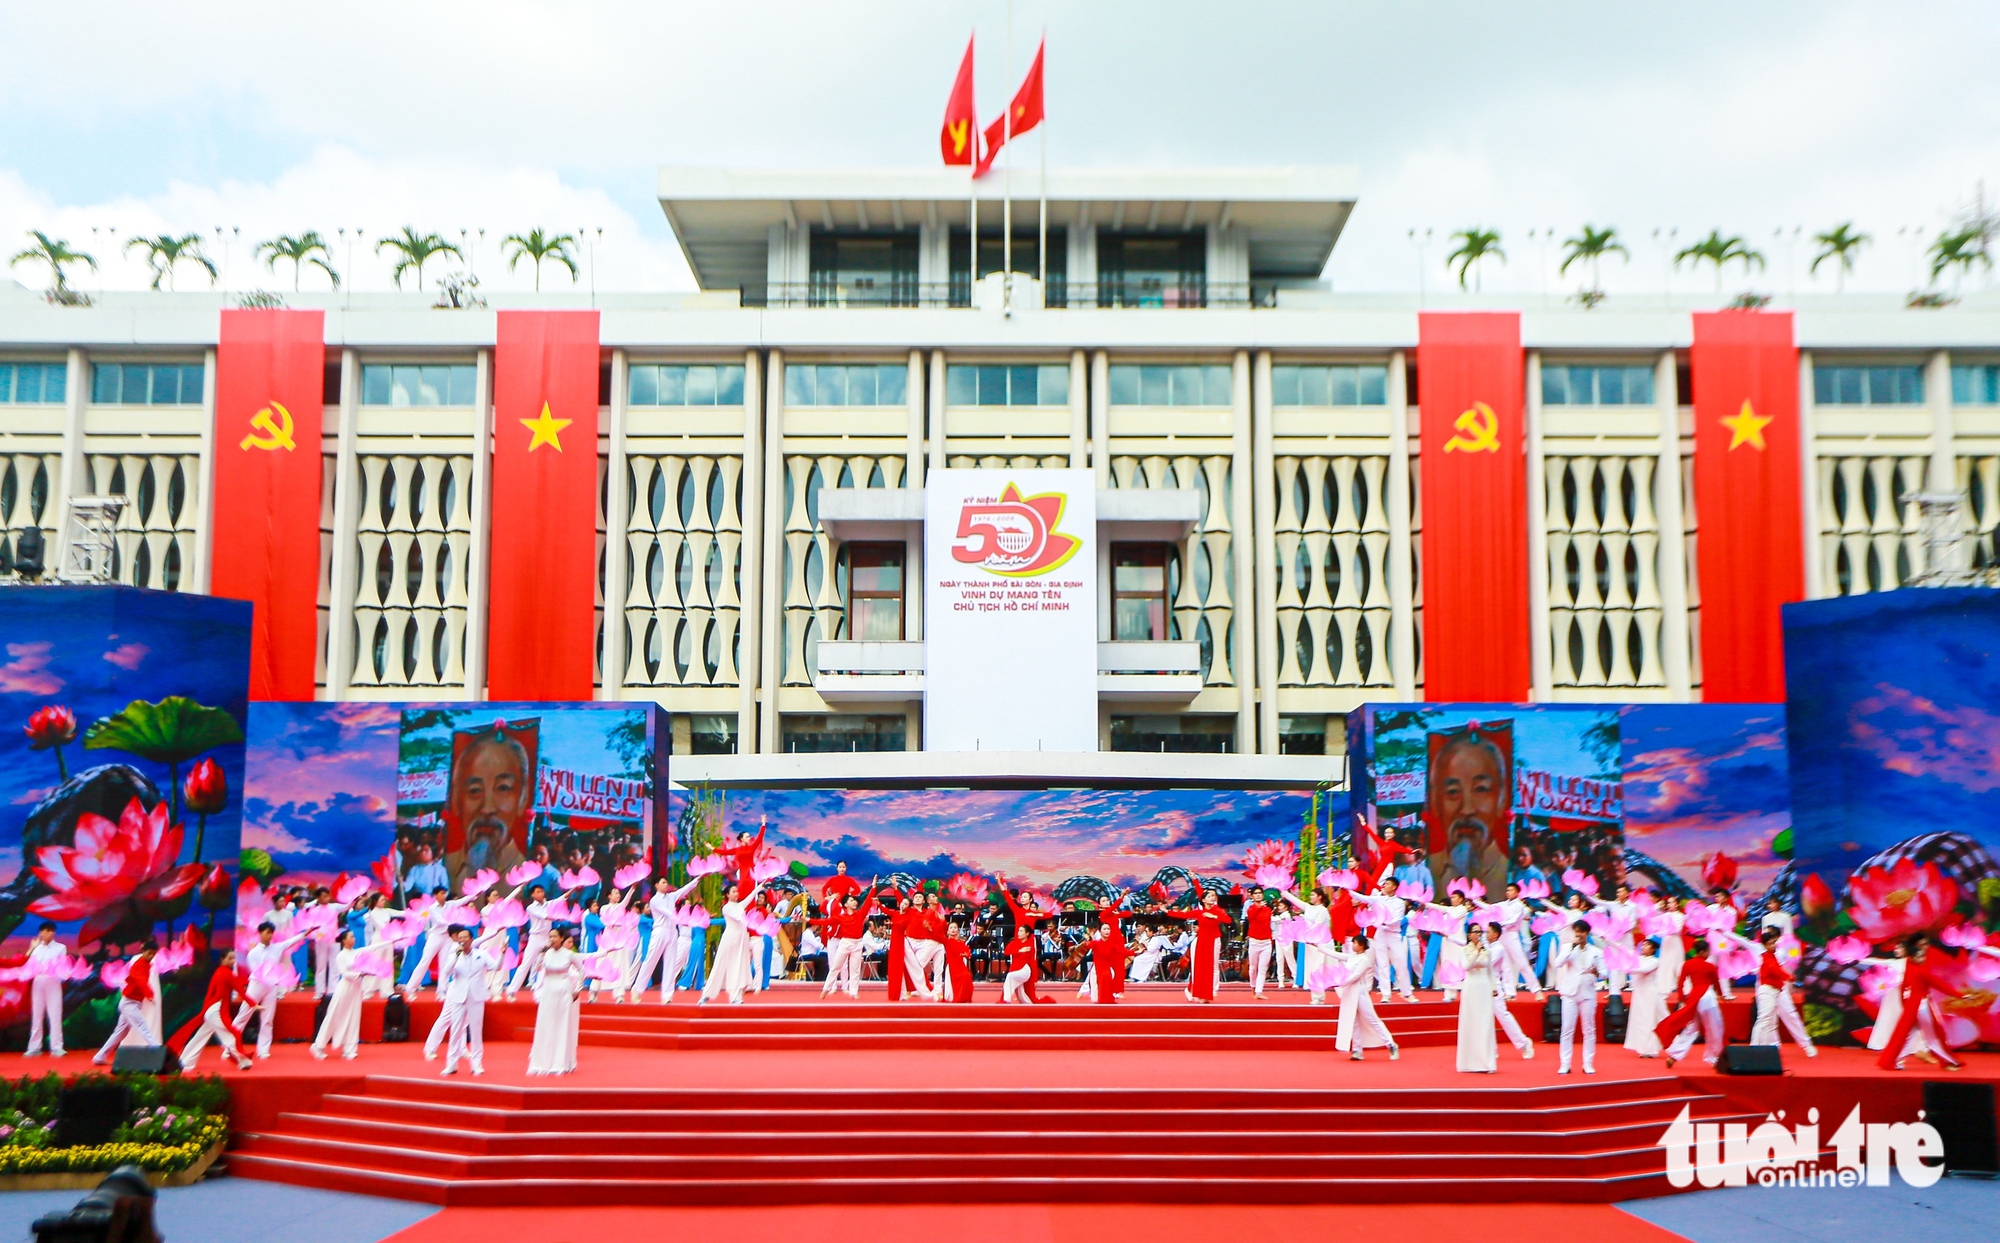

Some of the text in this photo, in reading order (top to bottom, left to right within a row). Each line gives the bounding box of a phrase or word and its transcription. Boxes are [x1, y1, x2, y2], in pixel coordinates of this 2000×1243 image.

[951, 505, 1043, 566] 50
[940, 579, 961, 588] NGÀY
[963, 579, 990, 588] THÀNH
[992, 579, 1008, 588] PHỐ
[1011, 580, 1023, 588] SÀI
[1025, 580, 1042, 588] GÒN
[961, 589, 1062, 600] VINH DỰ MANG TÊN
[953, 600, 1070, 612] CHỦ TỊCH HỒ CHÍ MINH
